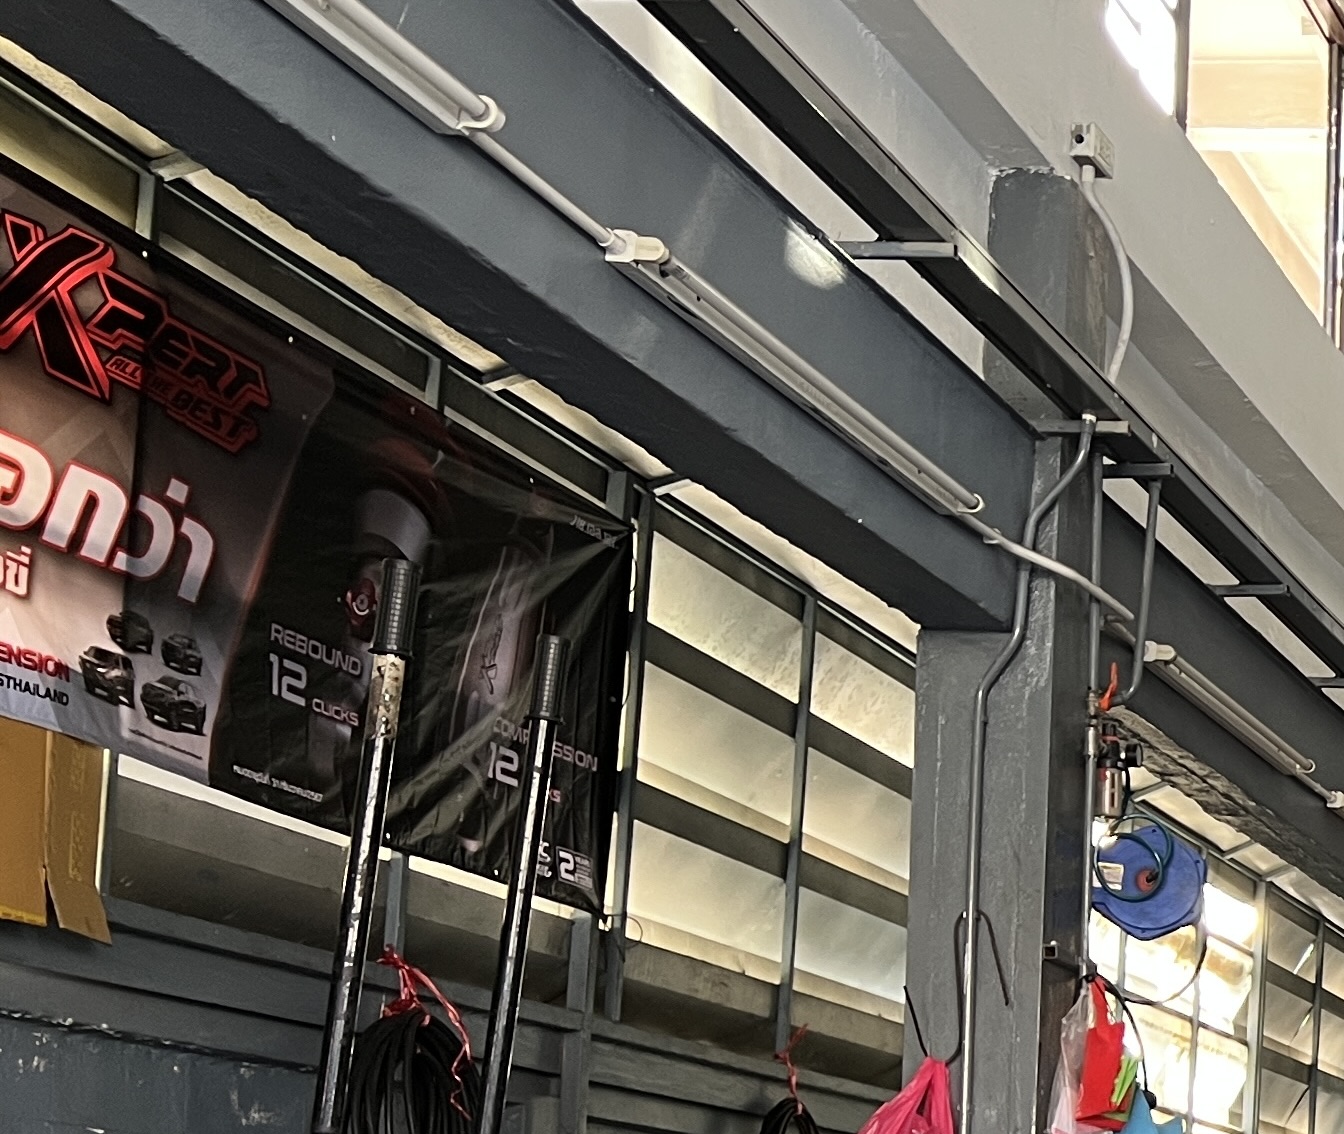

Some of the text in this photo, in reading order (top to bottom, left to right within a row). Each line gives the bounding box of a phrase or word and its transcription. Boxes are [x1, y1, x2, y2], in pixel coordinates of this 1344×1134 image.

[105, 355, 143, 385] ALL
[269, 622, 362, 677] REBOUND
[268, 652, 308, 707] 12
[312, 697, 360, 727] CLICKS
[487, 741, 520, 788] 12
